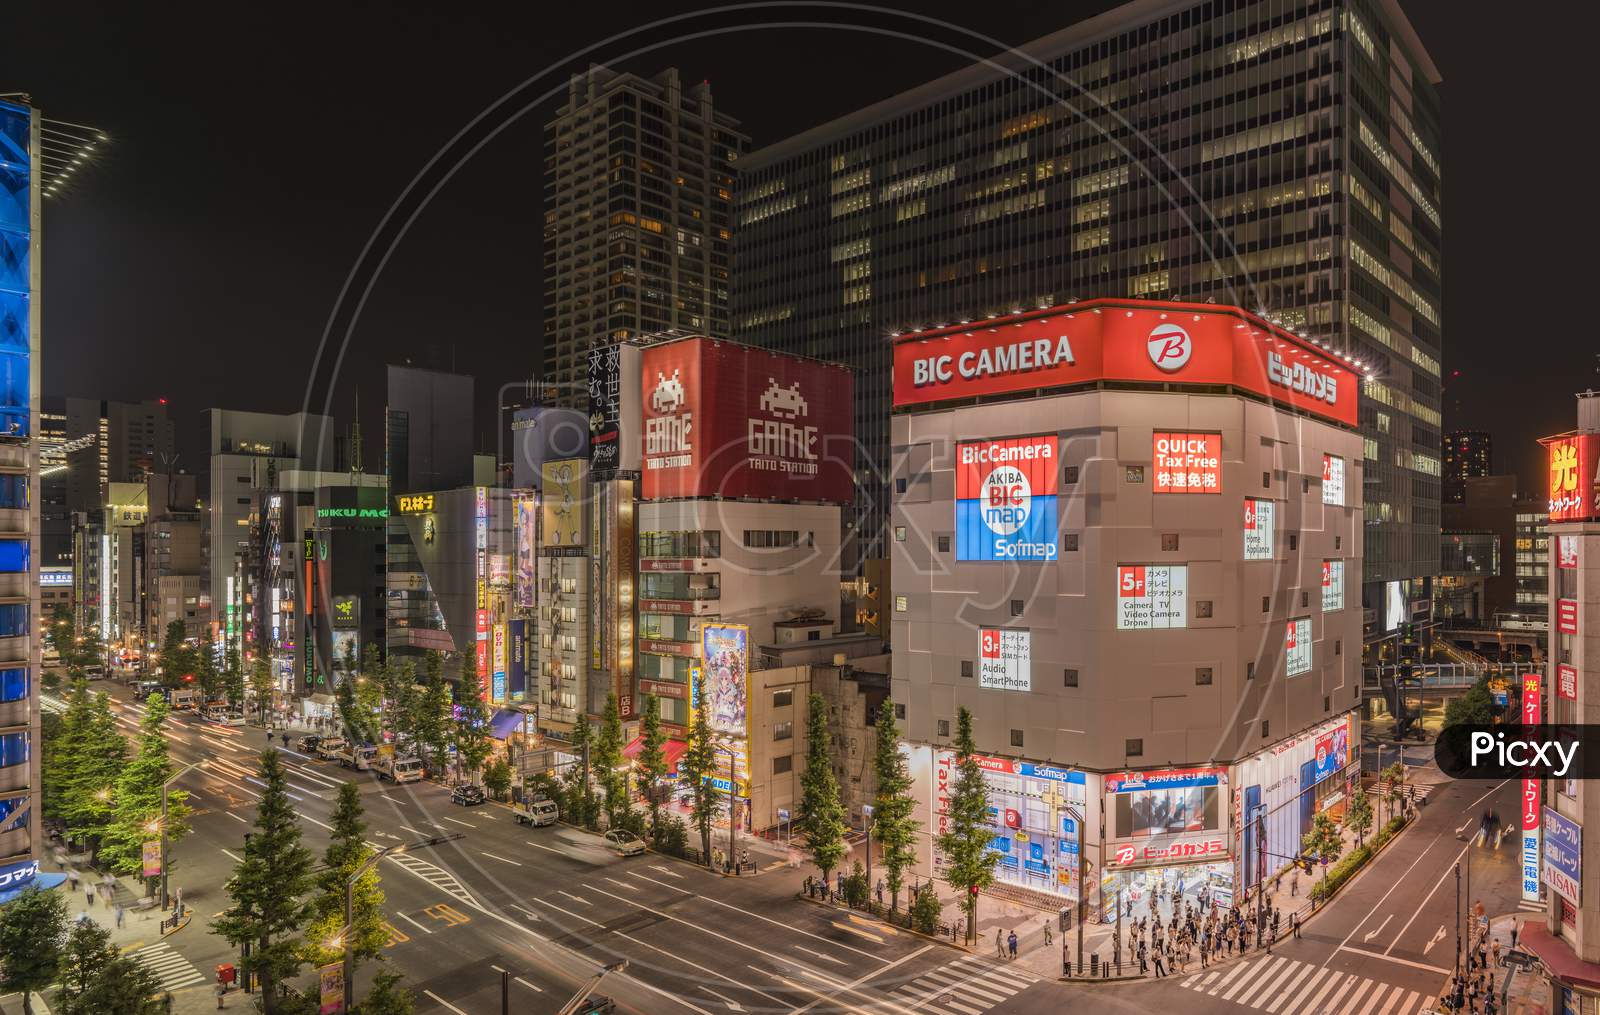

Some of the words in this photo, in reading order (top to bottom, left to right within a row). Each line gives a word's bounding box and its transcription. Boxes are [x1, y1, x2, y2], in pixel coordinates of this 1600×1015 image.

[913, 355, 952, 386] BIC
[958, 335, 1076, 380] CAMERA
[1267, 350, 1338, 404] ビックカメラ
[646, 412, 692, 455] GAME
[748, 417, 818, 461] GAME
[962, 443, 1052, 465] BicCamera
[1157, 439, 1207, 454] QUICK
[647, 456, 664, 470] TAITO
[665, 454, 692, 469] STATION
[749, 457, 777, 472] TAITO
[779, 460, 818, 475] STATION
[1157, 454, 1183, 468] Tax
[1186, 454, 1218, 468] Free
[1323, 461, 1331, 476] 7F
[1551, 444, 1579, 493] 光
[988, 472, 1023, 485] AKIBA
[1157, 471, 1217, 488] 快速免税
[989, 485, 1024, 507] BIC
[1548, 496, 1582, 514] ネットワーク
[986, 507, 1026, 529] map
[1245, 506, 1256, 525] 6F
[1246, 535, 1261, 544] Home
[995, 538, 1057, 561] Sofmap
[1246, 545, 1270, 557] Appliance
[1122, 573, 1143, 591] 5F
[1147, 570, 1168, 578] カメラ
[1147, 580, 1168, 588] テレビ
[1124, 619, 1148, 627] Drone
[1149, 610, 1181, 618] Camera
[983, 635, 999, 653] 3F
[1287, 627, 1297, 643] 4F
[982, 664, 1007, 674] Audio
[982, 675, 1029, 687] SmartPhone
[938, 757, 951, 792] Tax
[1034, 766, 1068, 781] Sofmap
[1143, 840, 1223, 859] ビックカメラ
[1524, 836, 1538, 893] 愛三電機
[1546, 870, 1577, 900] AISAN
[1063, 911, 1070, 921] P
